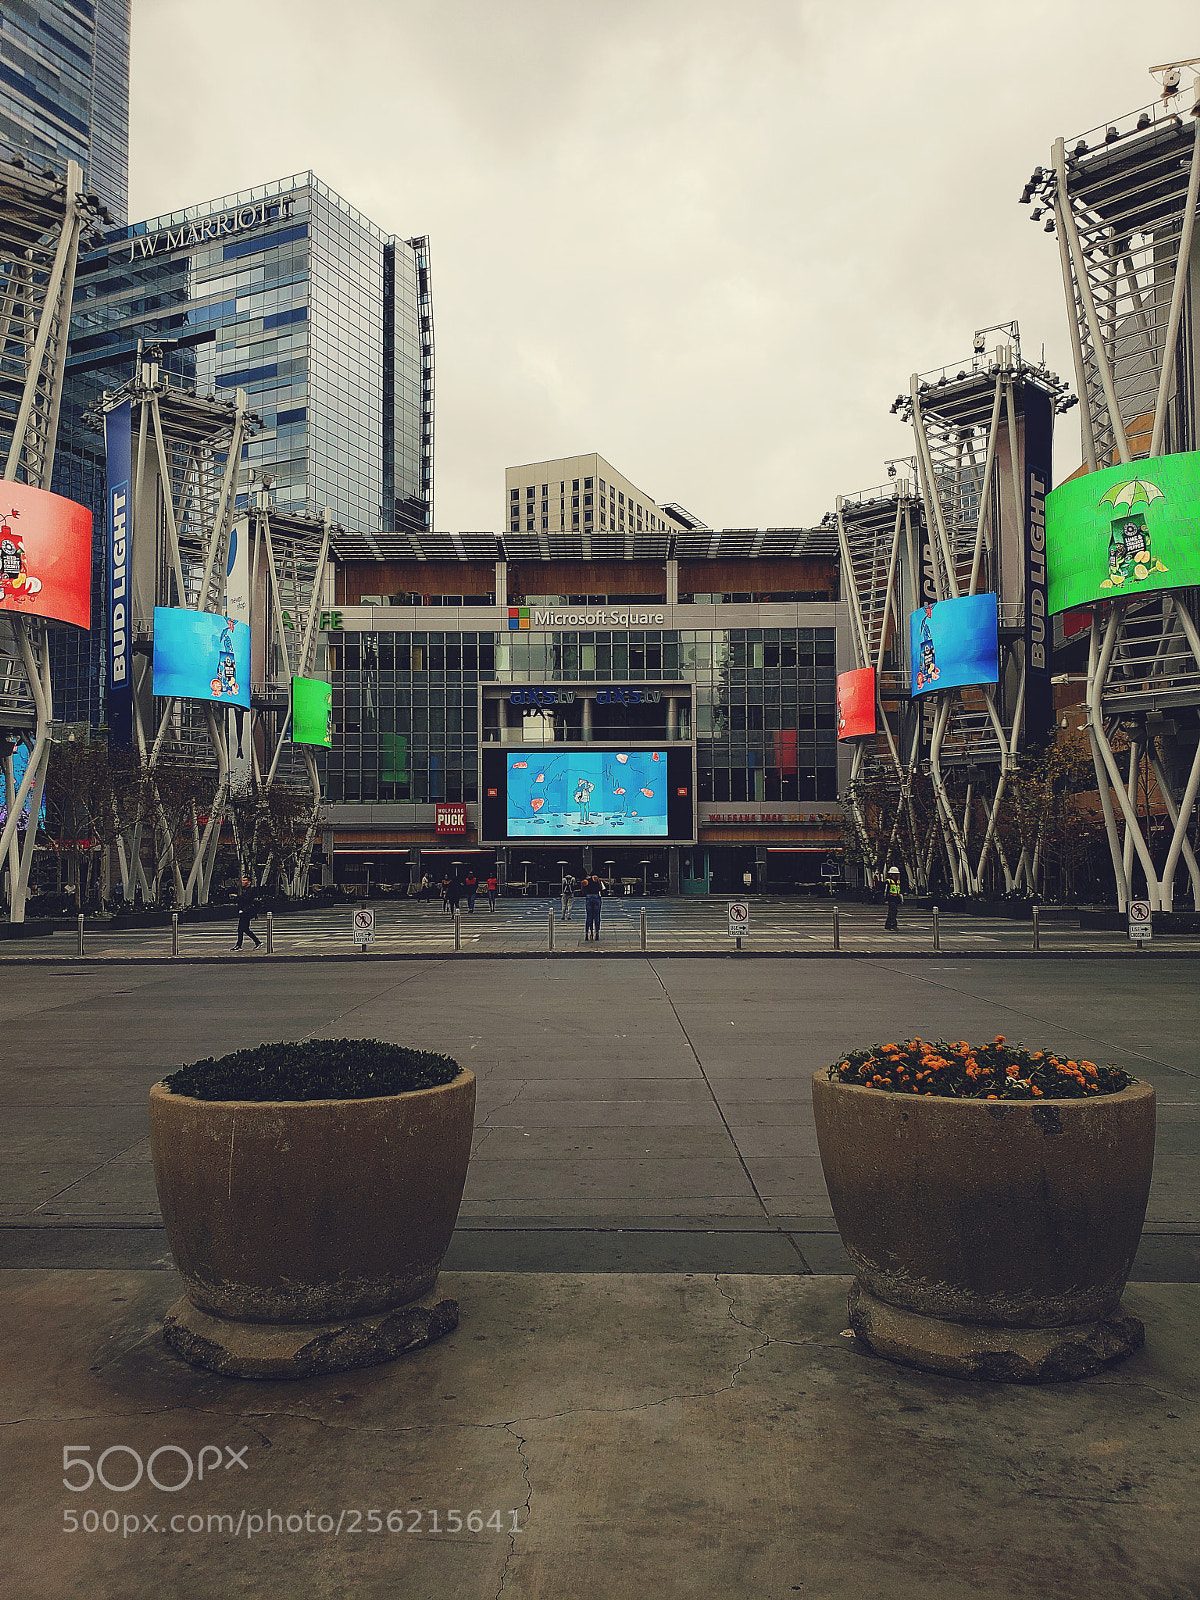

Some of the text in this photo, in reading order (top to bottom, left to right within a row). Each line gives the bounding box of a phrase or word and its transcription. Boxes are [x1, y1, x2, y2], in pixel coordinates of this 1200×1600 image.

[128, 194, 293, 263] JW MARRIOTT
[1030, 472, 1046, 669] BUD LIGHT
[113, 492, 126, 682] BUD LIGHT
[534, 610, 664, 628] Microsoft Square
[510, 687, 576, 708] axs.tv
[596, 687, 662, 708] axs.tv
[437, 814, 465, 826] PUCK
